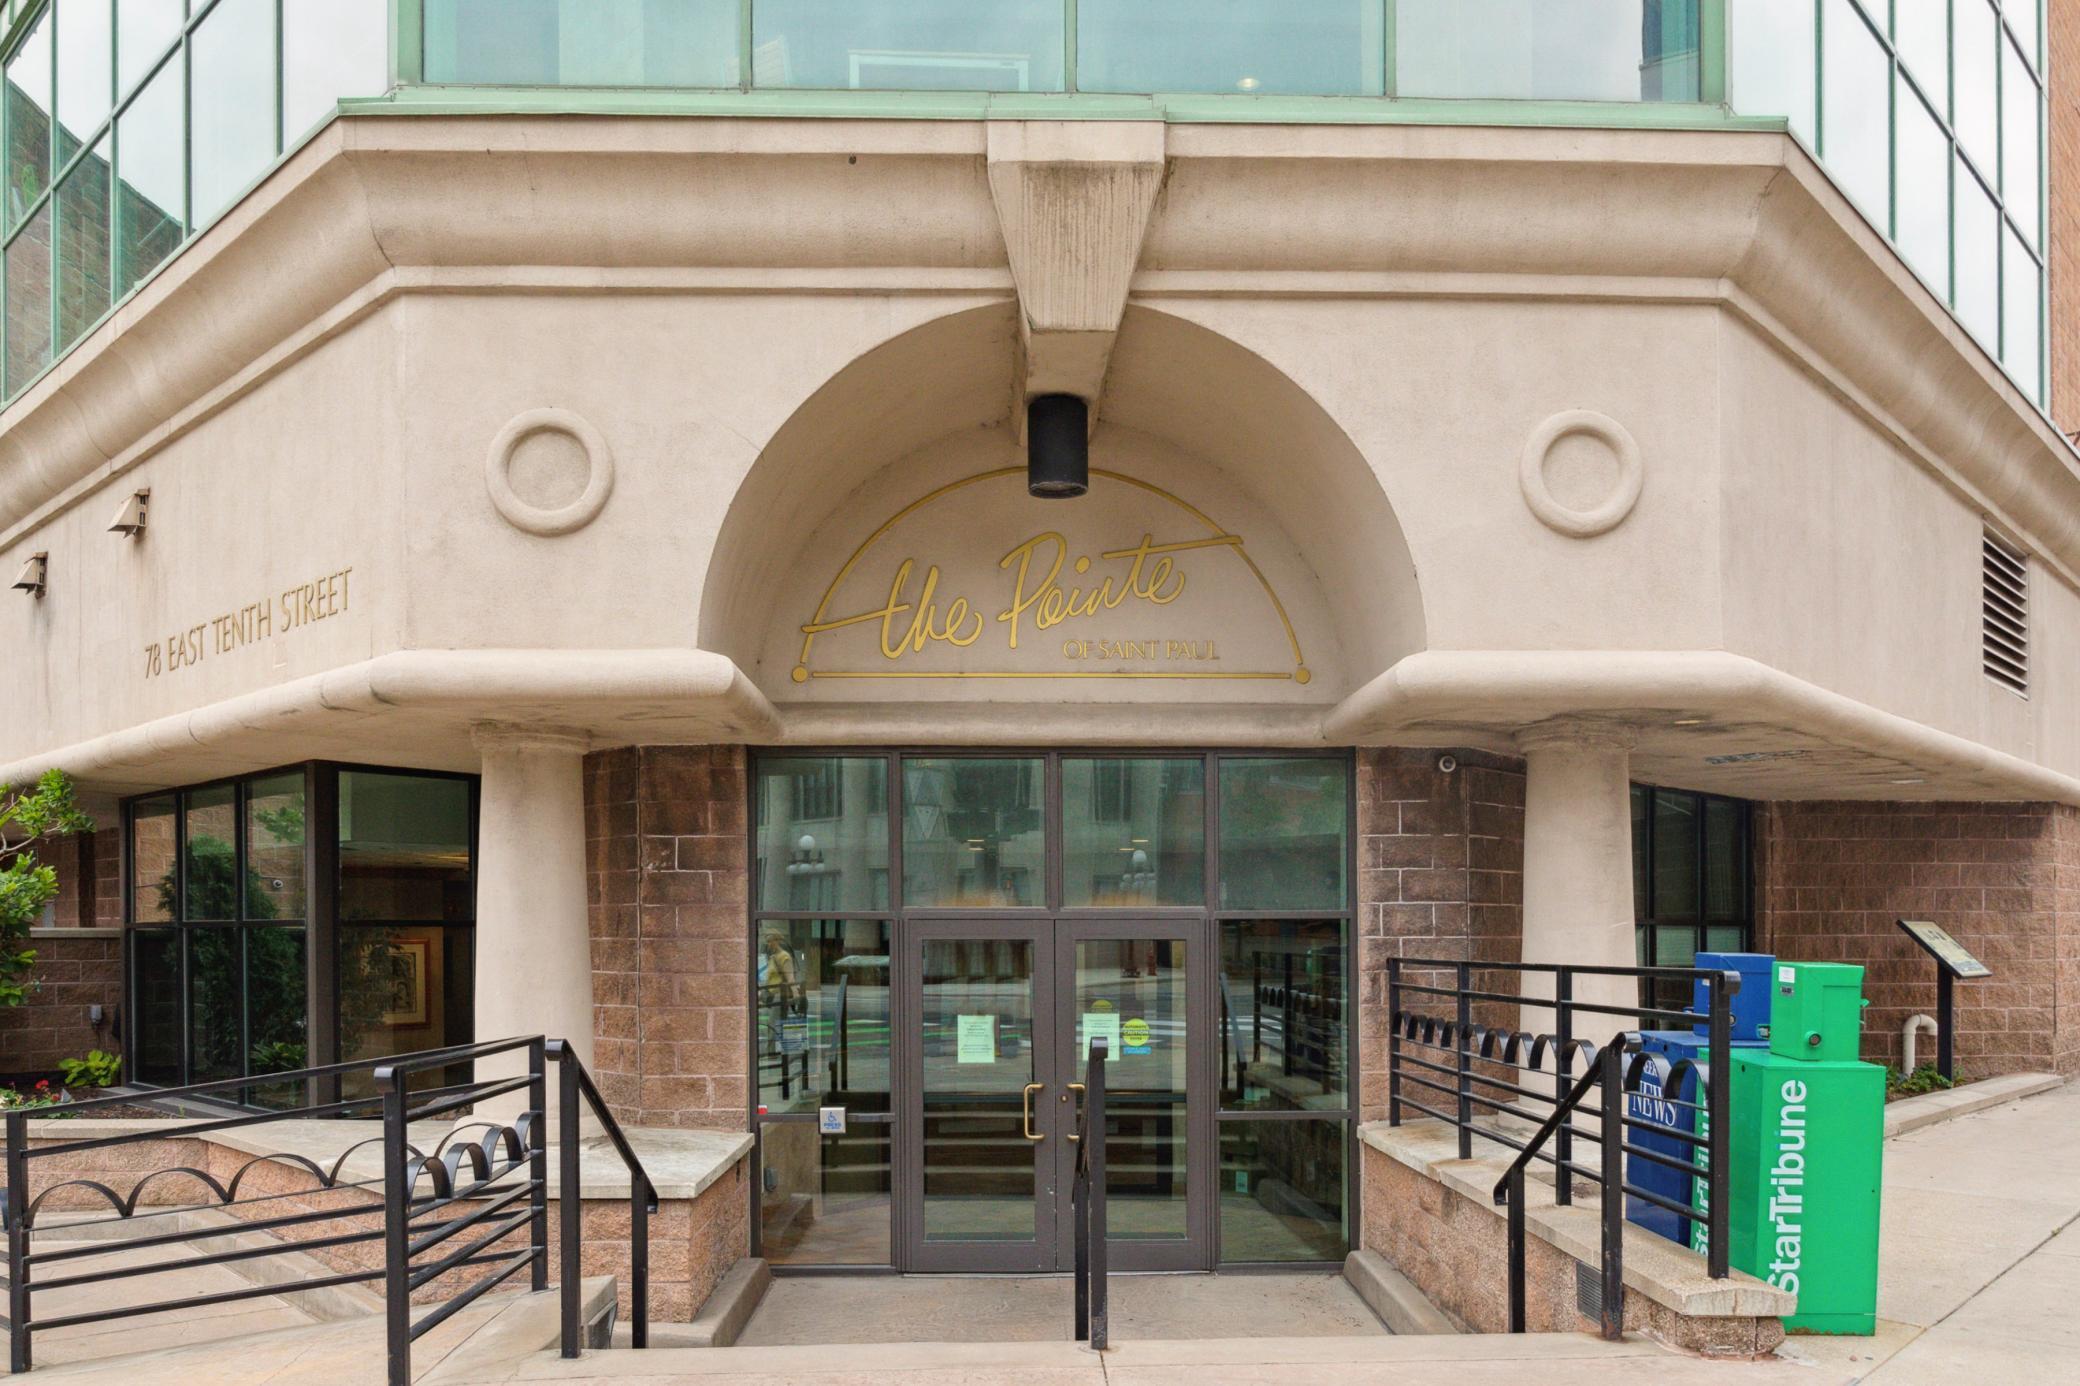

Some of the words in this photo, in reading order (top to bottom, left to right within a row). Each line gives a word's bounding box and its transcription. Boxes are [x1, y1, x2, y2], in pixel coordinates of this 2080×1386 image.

[144, 642, 162, 679] 78
[168, 623, 207, 672] EAST
[211, 598, 272, 654] TENTH
[280, 566, 353, 633] STREET
[802, 557, 983, 659] the
[998, 531, 1243, 649] Pointe
[1063, 639, 1093, 660] OF
[1098, 639, 1160, 660] SAINT
[1167, 639, 1221, 661] PAUL
[1632, 1080, 1678, 1127] NEWS
[1766, 1079, 1808, 1297] StarTribune
